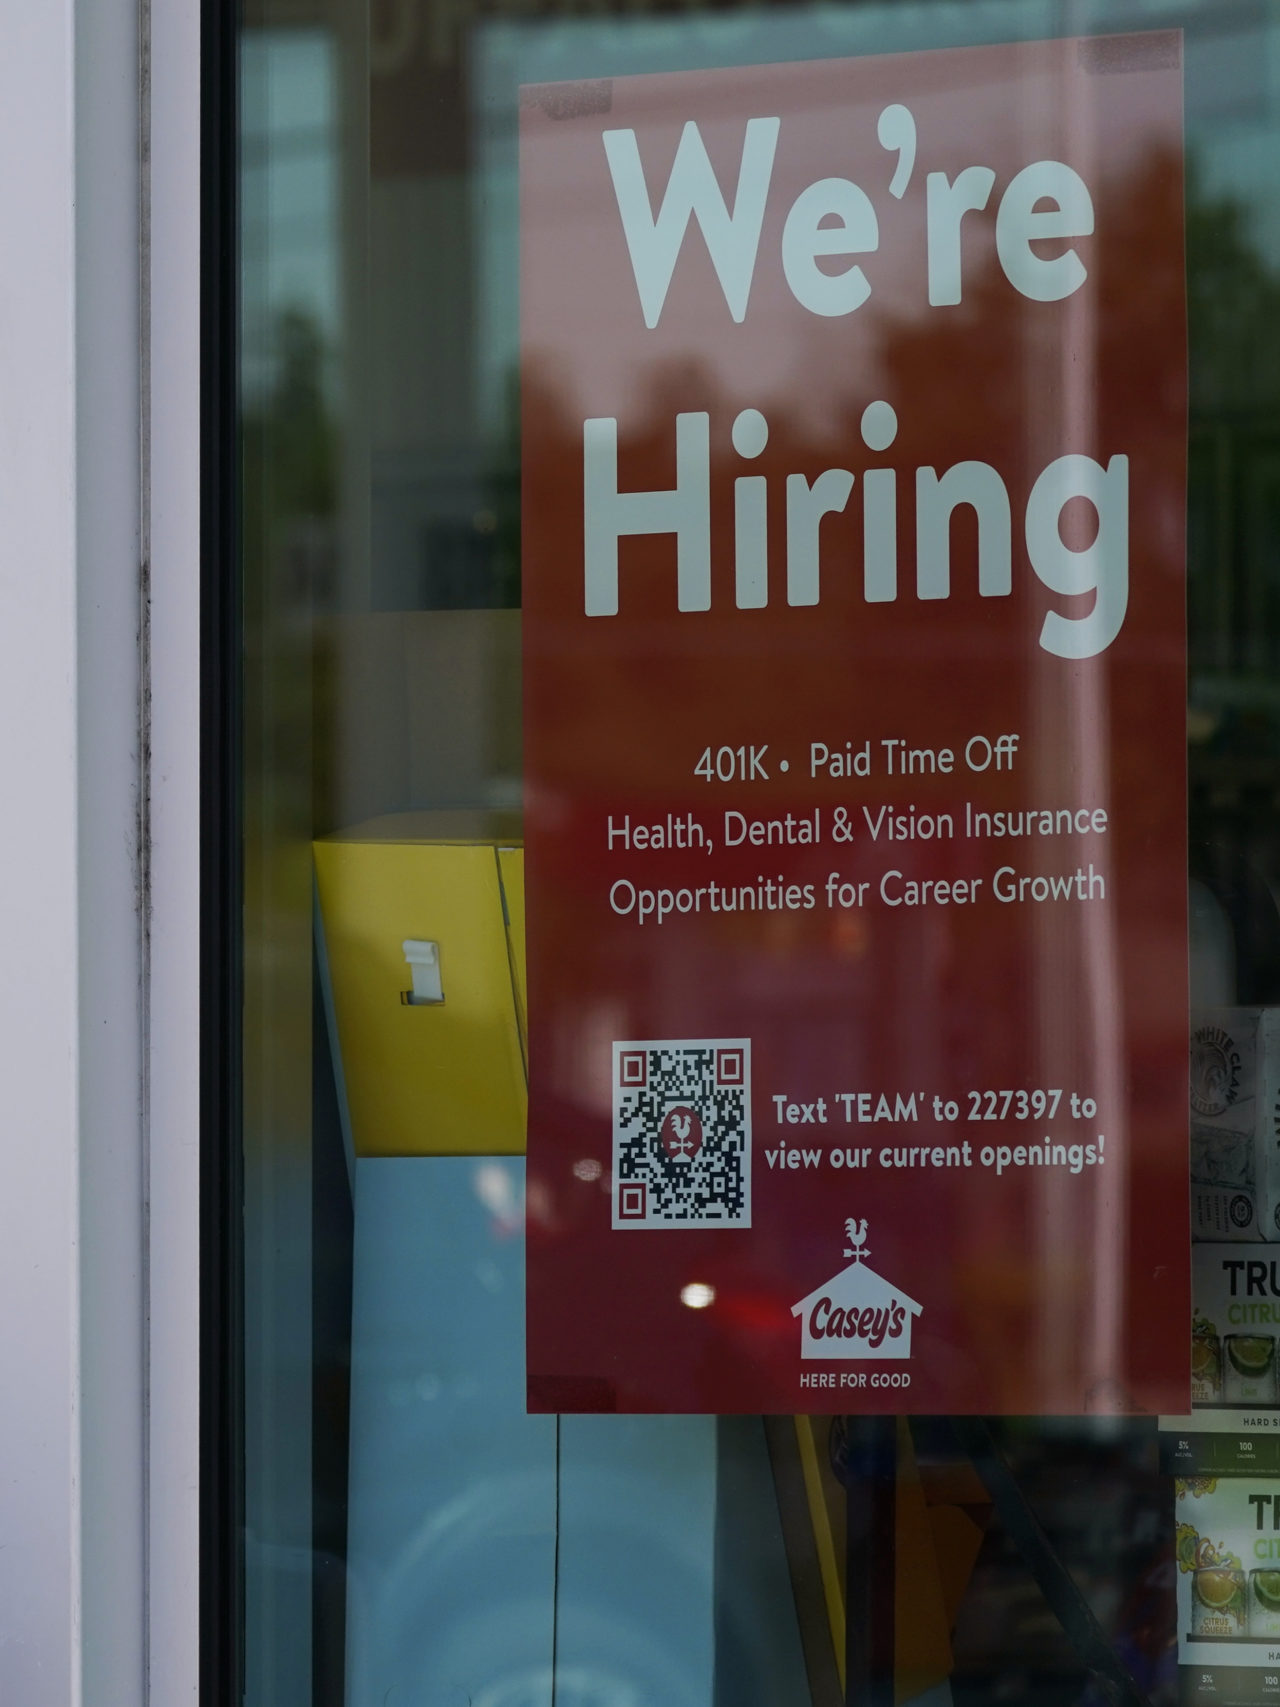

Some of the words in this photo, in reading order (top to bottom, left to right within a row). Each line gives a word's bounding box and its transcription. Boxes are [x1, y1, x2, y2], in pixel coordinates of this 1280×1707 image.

[583, 401, 1130, 659] Hiring
[694, 744, 770, 783] 401K
[810, 741, 871, 778] Paid
[881, 738, 955, 775] Time
[965, 734, 1020, 771] Off
[607, 813, 713, 856] Health,
[724, 808, 821, 846] Dental
[831, 806, 854, 843] &
[862, 804, 954, 841] Vision
[966, 802, 1109, 838] Insurance
[609, 875, 816, 925] Opportunities
[825, 872, 870, 908] for
[879, 870, 983, 906] Career
[992, 864, 1106, 903] Growth
[1194, 1026, 1235, 1052] WHITE
[1226, 1052, 1242, 1105] CLAW
[772, 1093, 828, 1125] Text
[931, 1095, 959, 1122] to
[967, 1089, 1063, 1122] 227397
[1070, 1092, 1097, 1119] to
[764, 1141, 822, 1171] view
[829, 1143, 871, 1169] our
[879, 1138, 973, 1169] current
[980, 1135, 1106, 1176] openings!
[799, 1373, 837, 1389] HERE
[840, 1373, 867, 1389] FOR
[870, 1373, 912, 1389] GOOD
[1243, 1418, 1270, 1426] HARD
[1178, 1441, 1189, 1450] 5%
[1239, 1442, 1253, 1451] 100
[1203, 1617, 1229, 1626] CITRUS
[1200, 1625, 1233, 1635] SQUEEZE
[1201, 1674, 1213, 1684] 5%
[1265, 1676, 1278, 1685] 100
